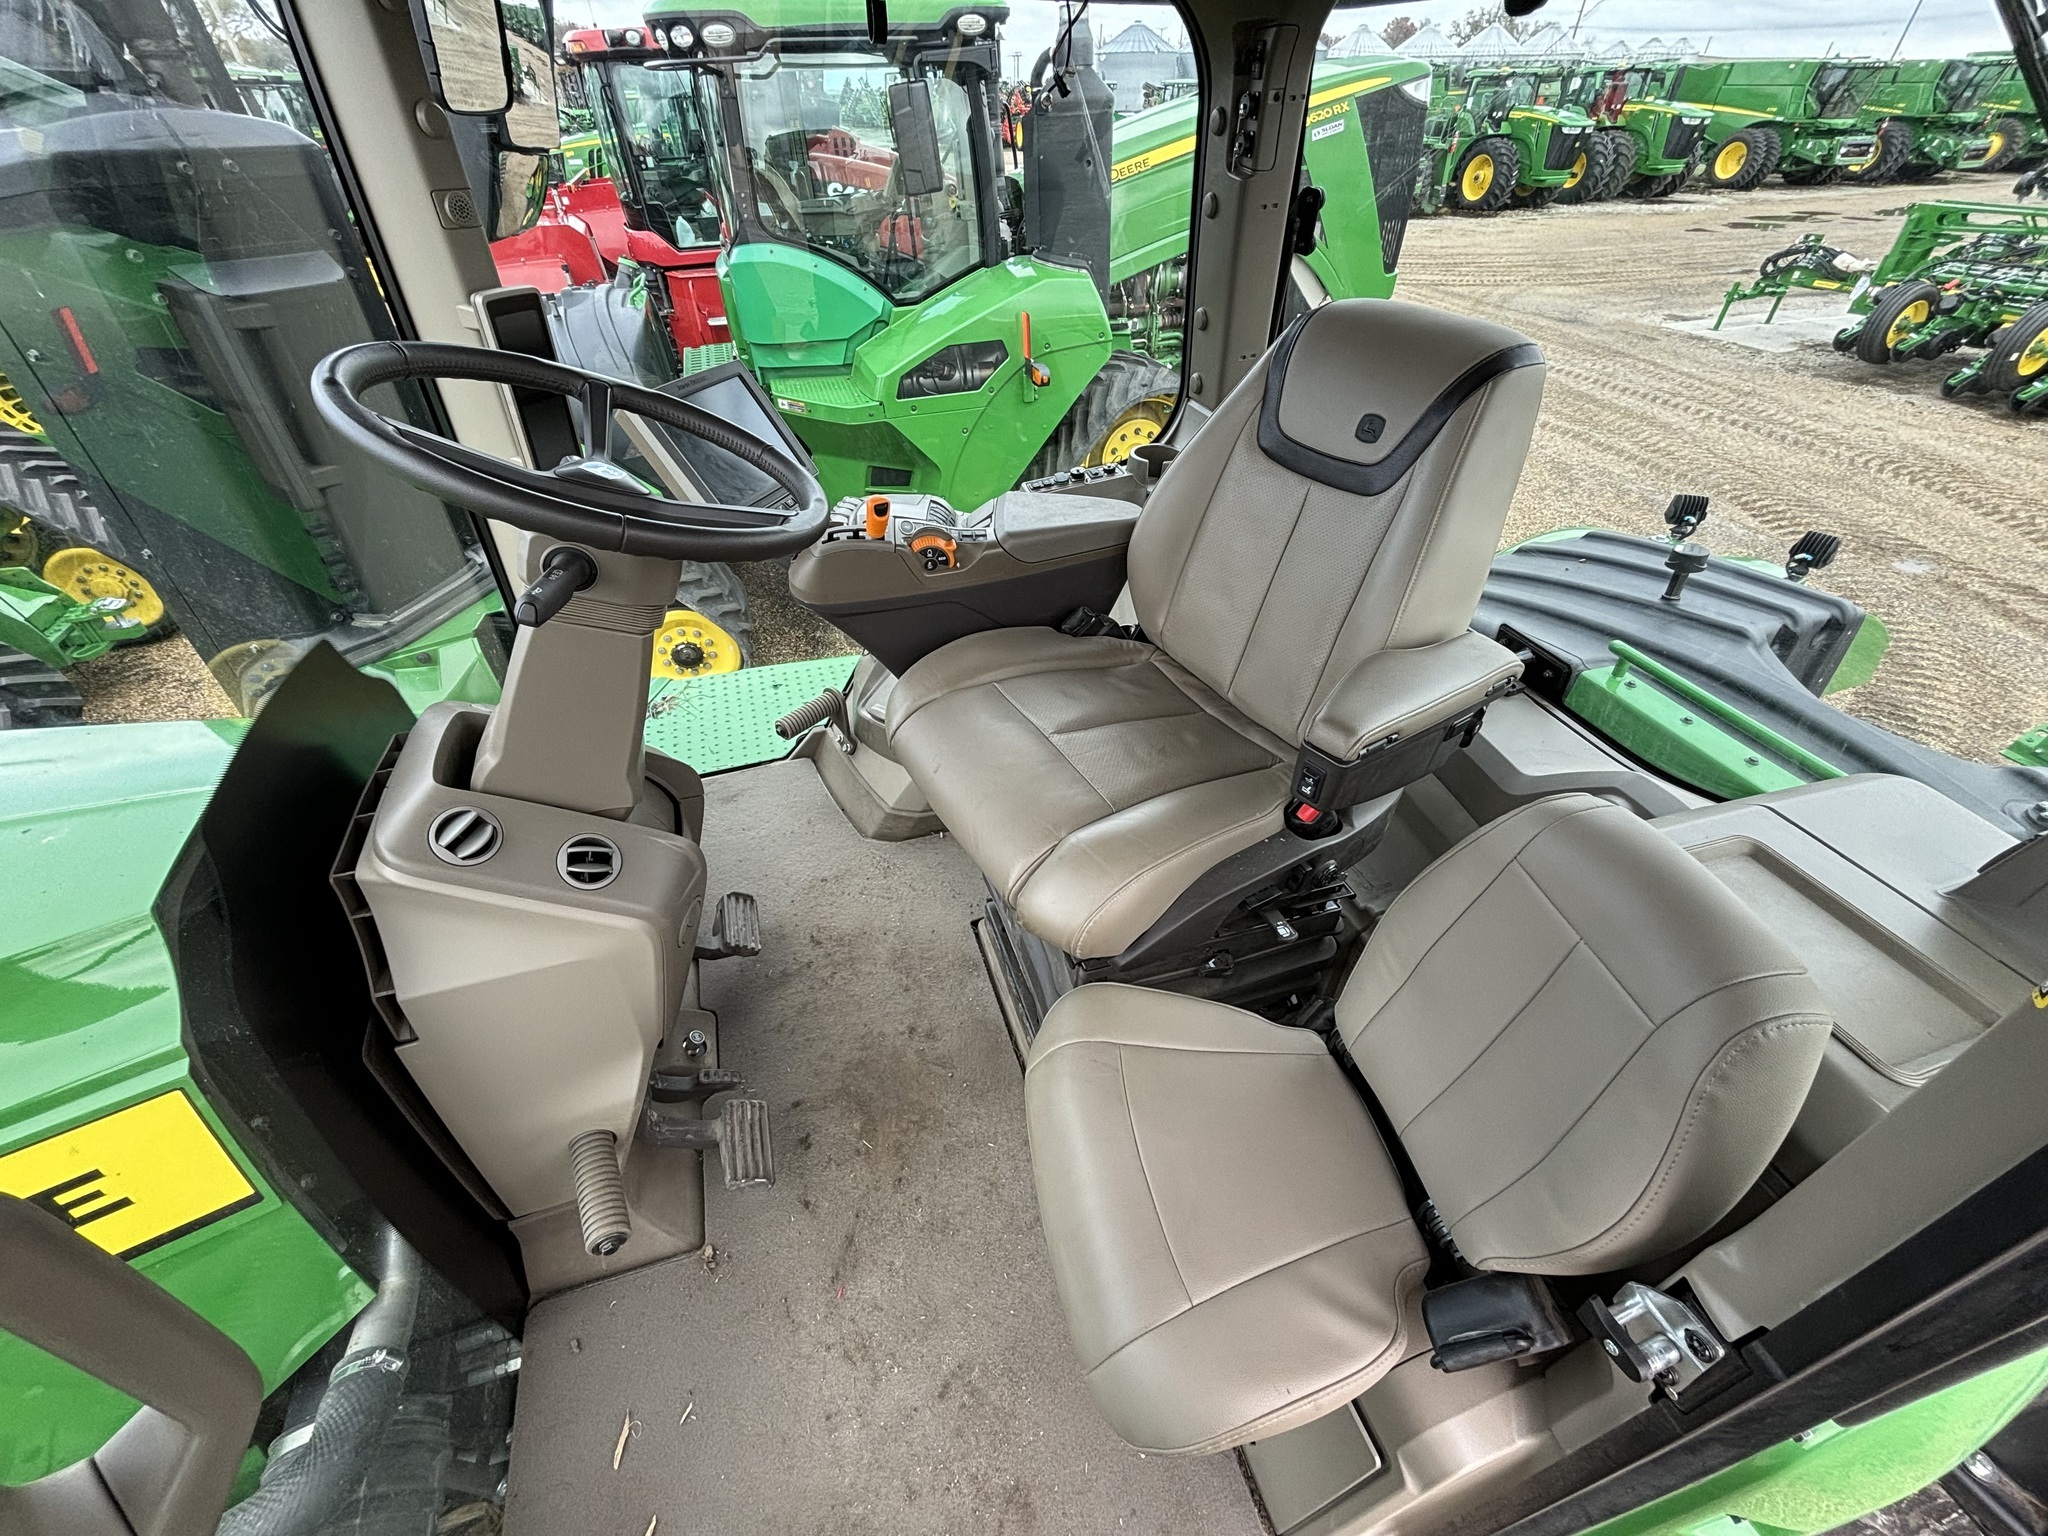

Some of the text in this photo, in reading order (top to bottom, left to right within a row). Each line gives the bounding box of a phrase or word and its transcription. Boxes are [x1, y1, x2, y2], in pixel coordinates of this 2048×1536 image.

[1333, 101, 1350, 115] RX
[1321, 122, 1343, 132] SLOAN
[1111, 158, 1151, 180] DEERE
